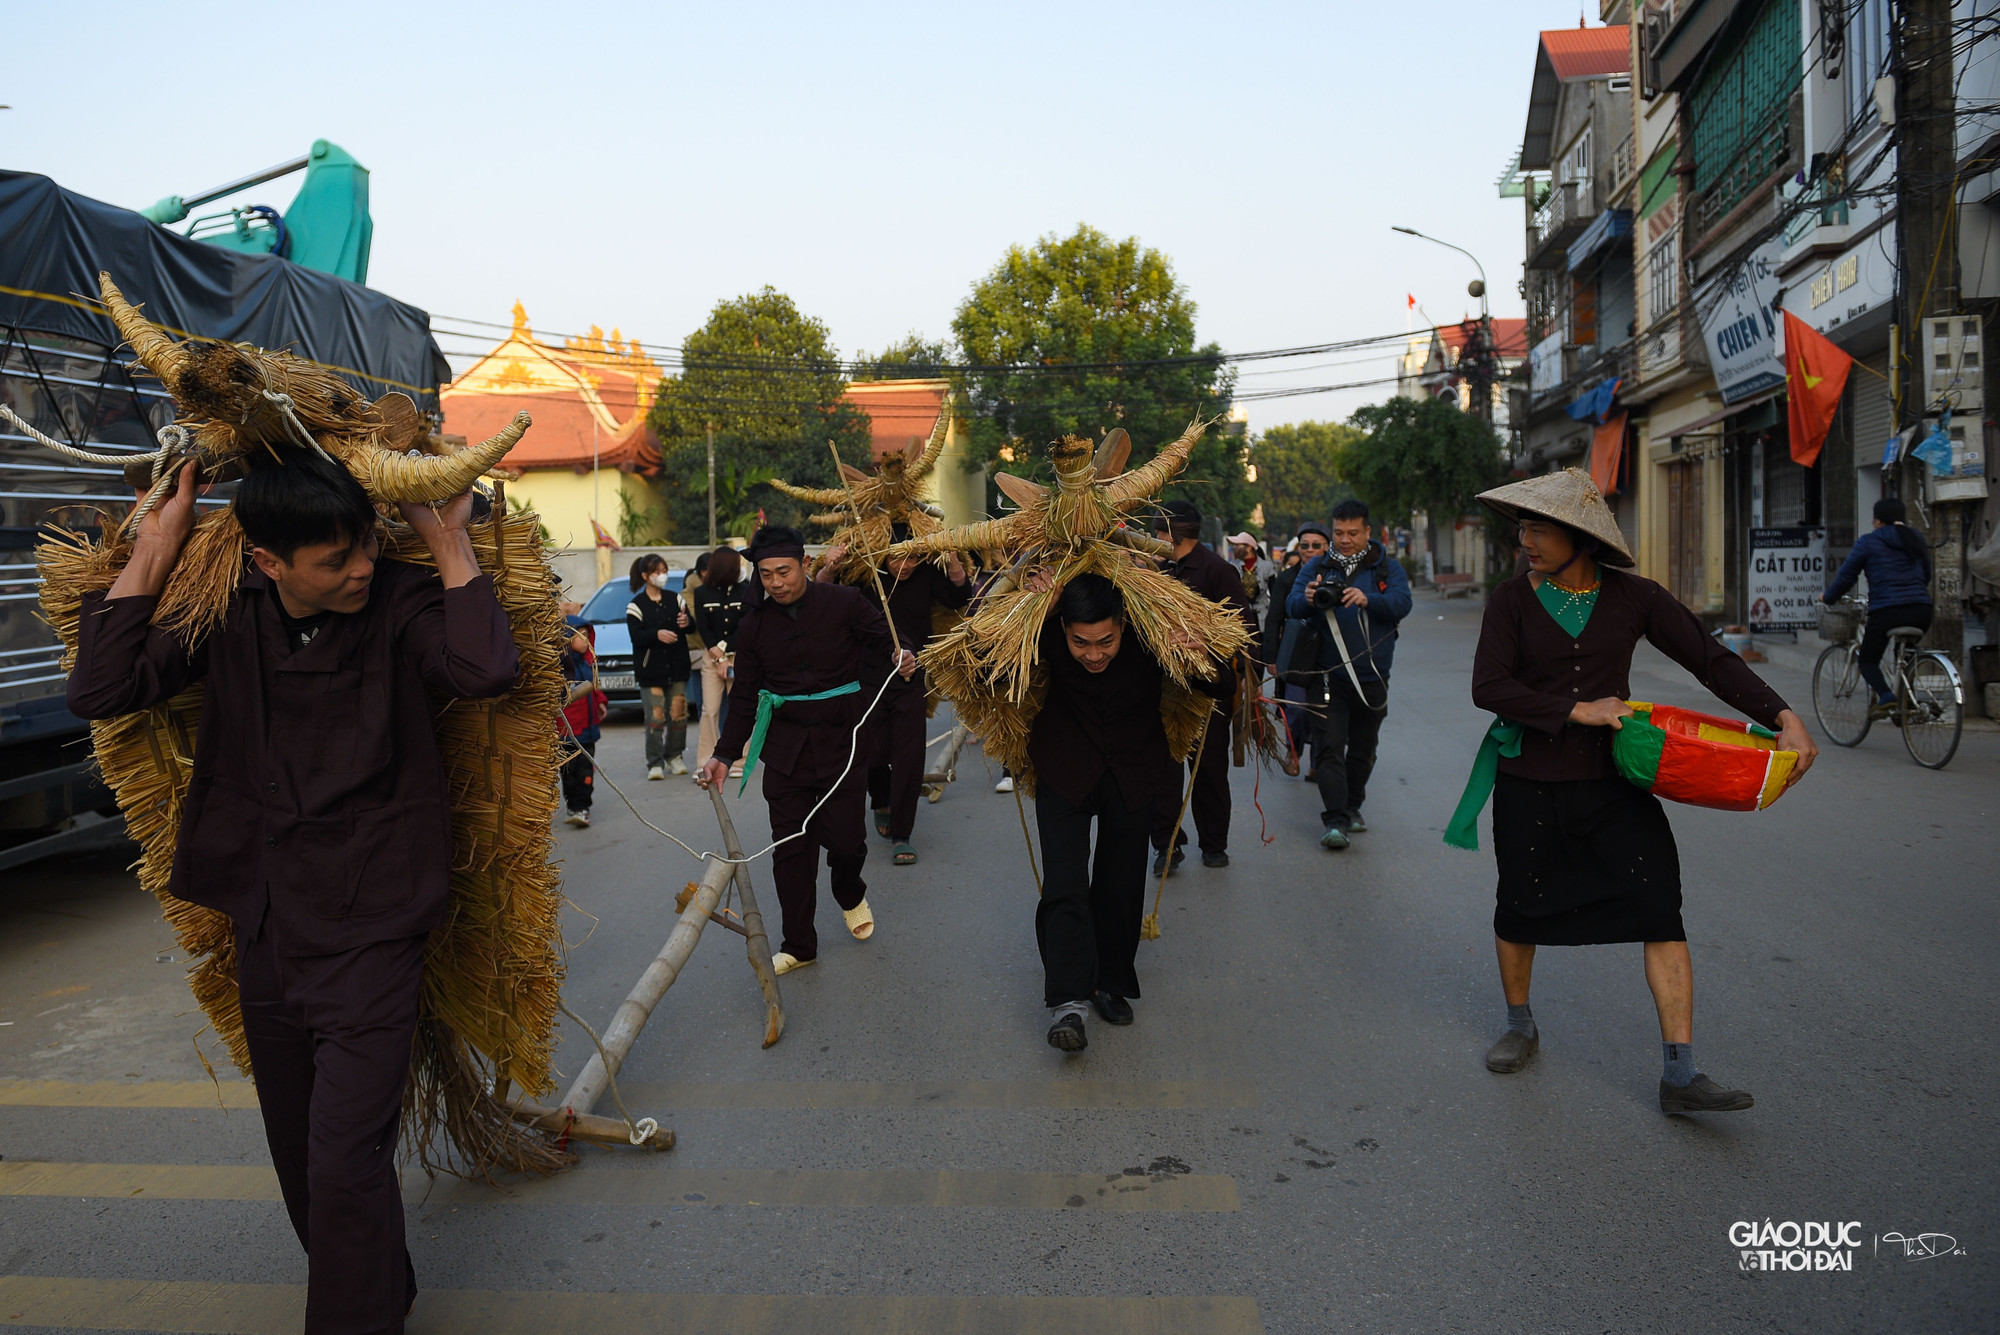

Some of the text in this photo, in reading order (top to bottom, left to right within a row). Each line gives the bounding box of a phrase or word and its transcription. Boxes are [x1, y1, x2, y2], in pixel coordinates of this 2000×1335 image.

[1837, 254, 1858, 294] HAIR
[1755, 552, 1787, 573] CẮT
[1791, 554, 1823, 573] TÓC
